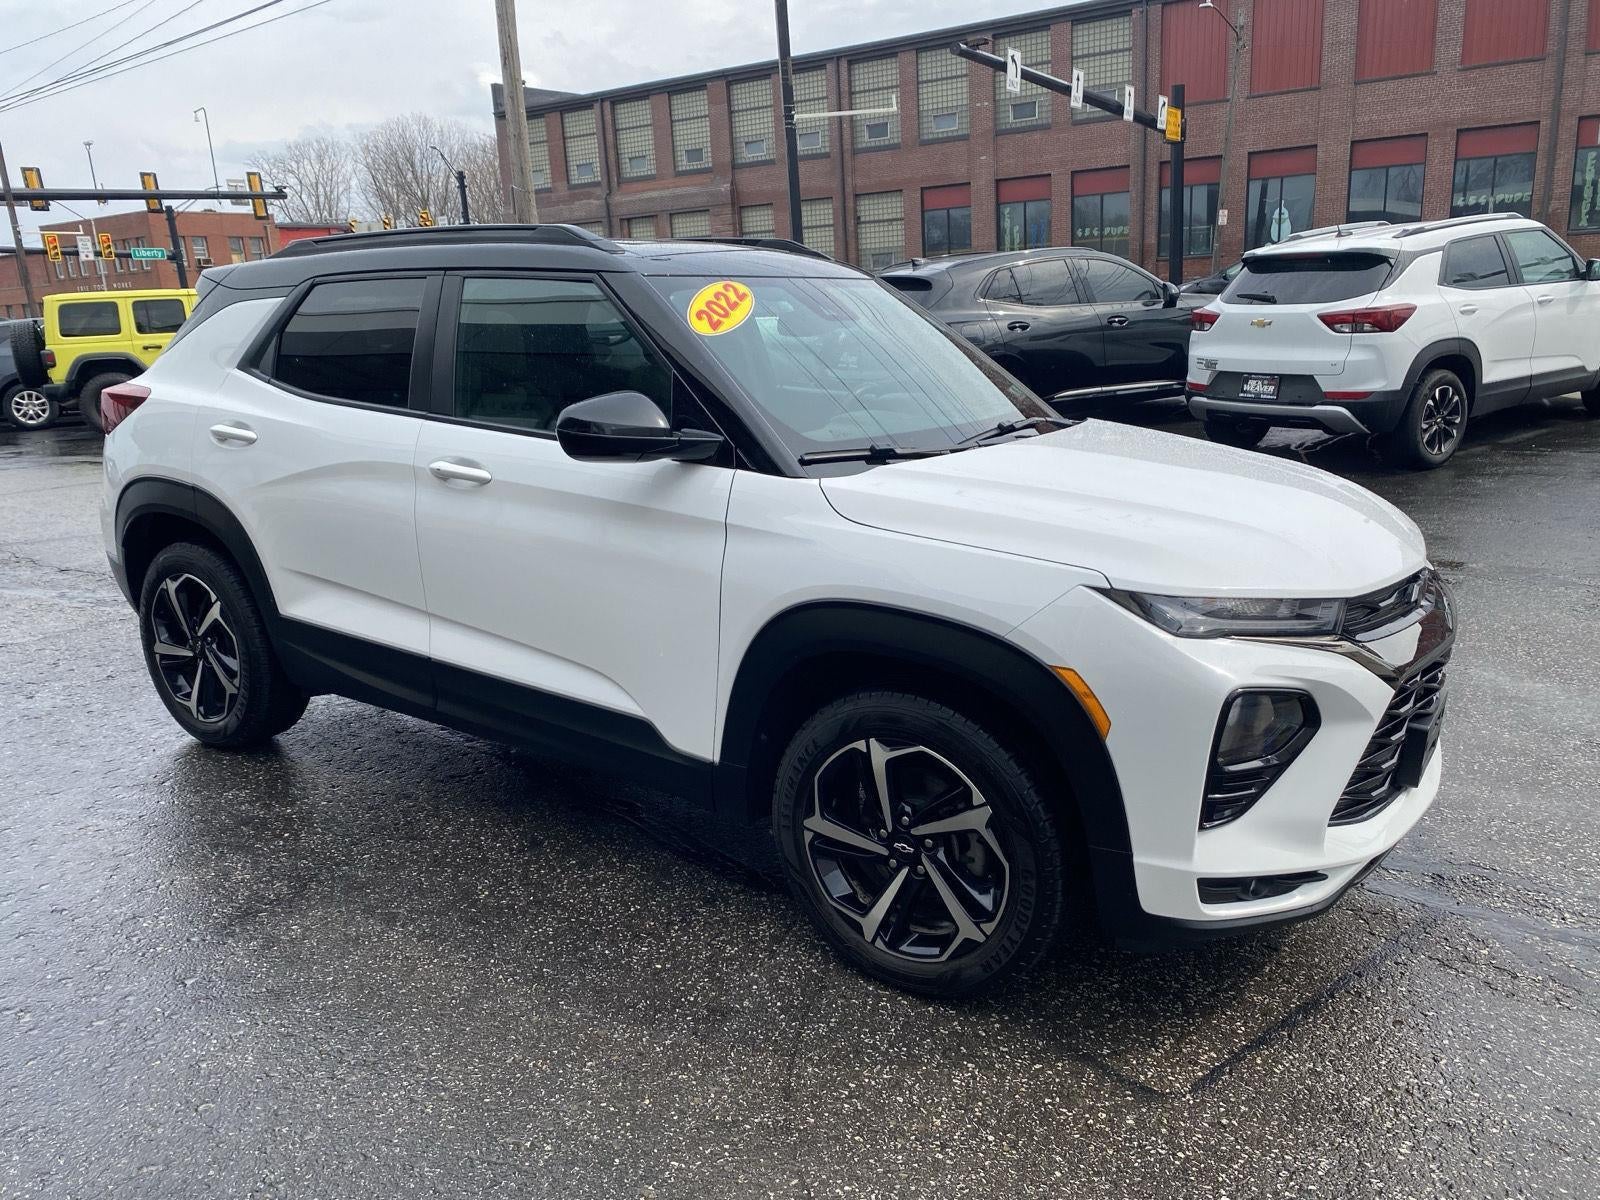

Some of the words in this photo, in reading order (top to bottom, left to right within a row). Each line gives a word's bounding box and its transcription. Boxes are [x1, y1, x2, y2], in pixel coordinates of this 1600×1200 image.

[135, 249, 162, 258] Liberty
[695, 283, 748, 332] 2022
[1243, 384, 1275, 393] WEAVER
[981, 867, 1036, 974] GOODYEAR
